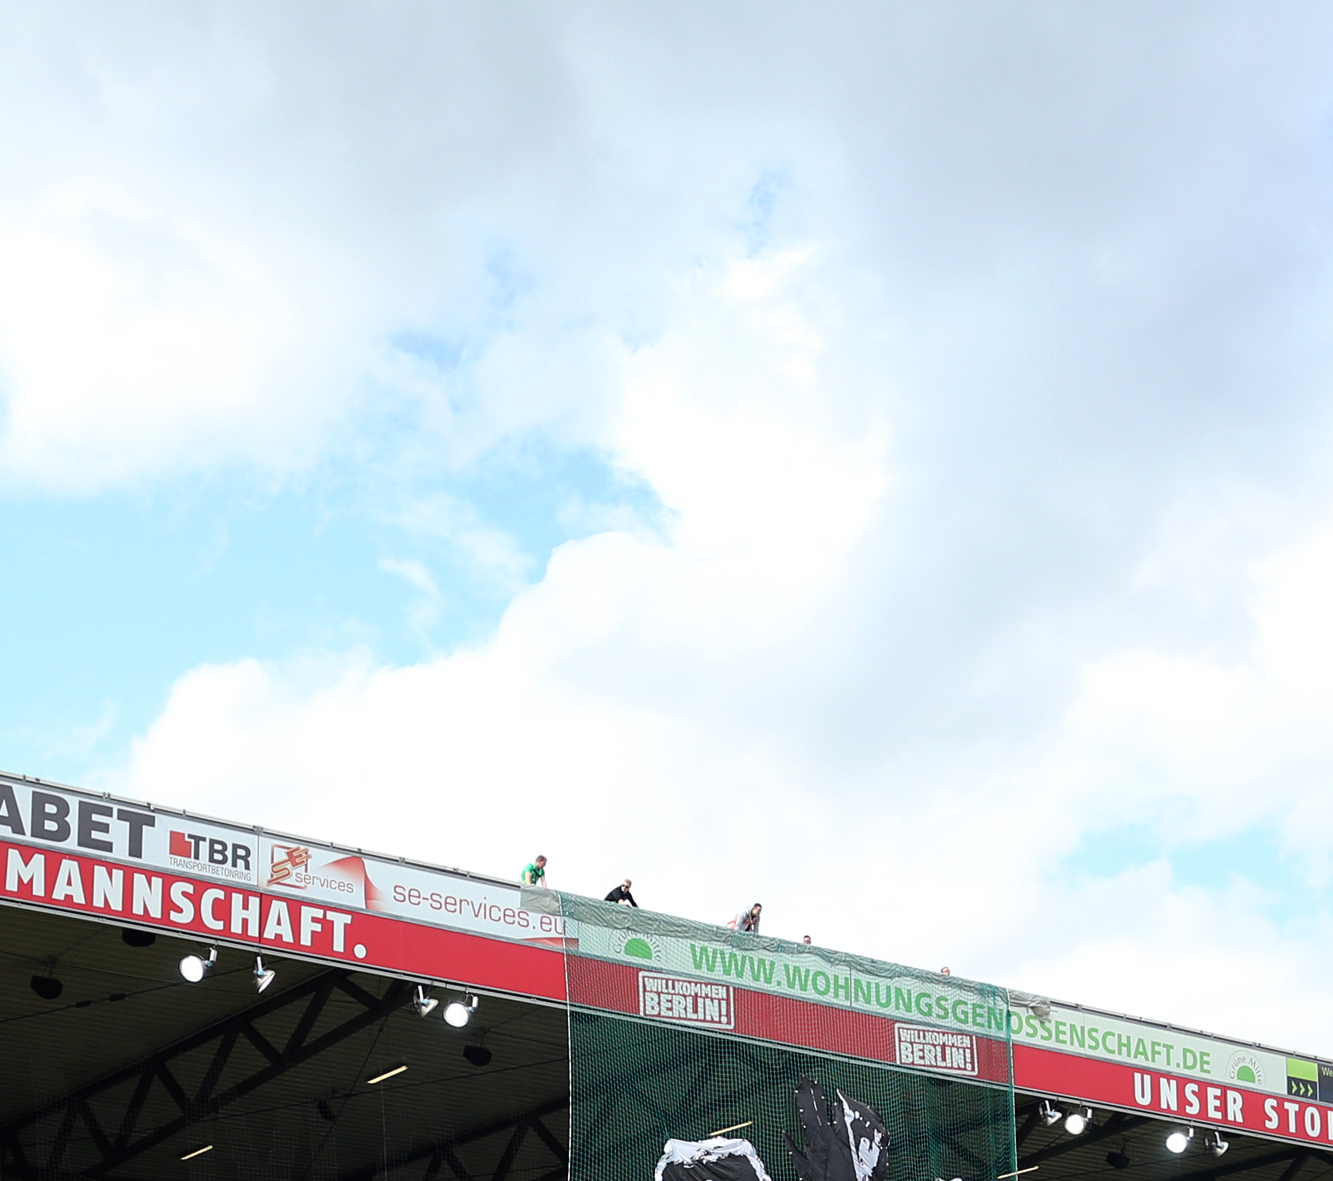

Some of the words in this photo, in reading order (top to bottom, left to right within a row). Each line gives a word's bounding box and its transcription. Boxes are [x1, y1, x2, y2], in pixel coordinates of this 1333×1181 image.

[187, 833, 252, 872] TBR
[169, 857, 253, 882] TRANSPORTBETONRING
[295, 872, 354, 895] services
[5, 848, 367, 959] MANNSCHAFT.
[393, 885, 565, 935] se-services.eu
[644, 977, 728, 999] WILLKOMMEN
[644, 992, 728, 1024] BERLIN!
[690, 943, 1211, 1075] WWW.WOHNUNGSGENOSSENSCHAFT.DE
[899, 1028, 971, 1048] WILLKOMMEN
[900, 1042, 972, 1071] BERLIN!
[1133, 1072, 1243, 1124] UNSER
